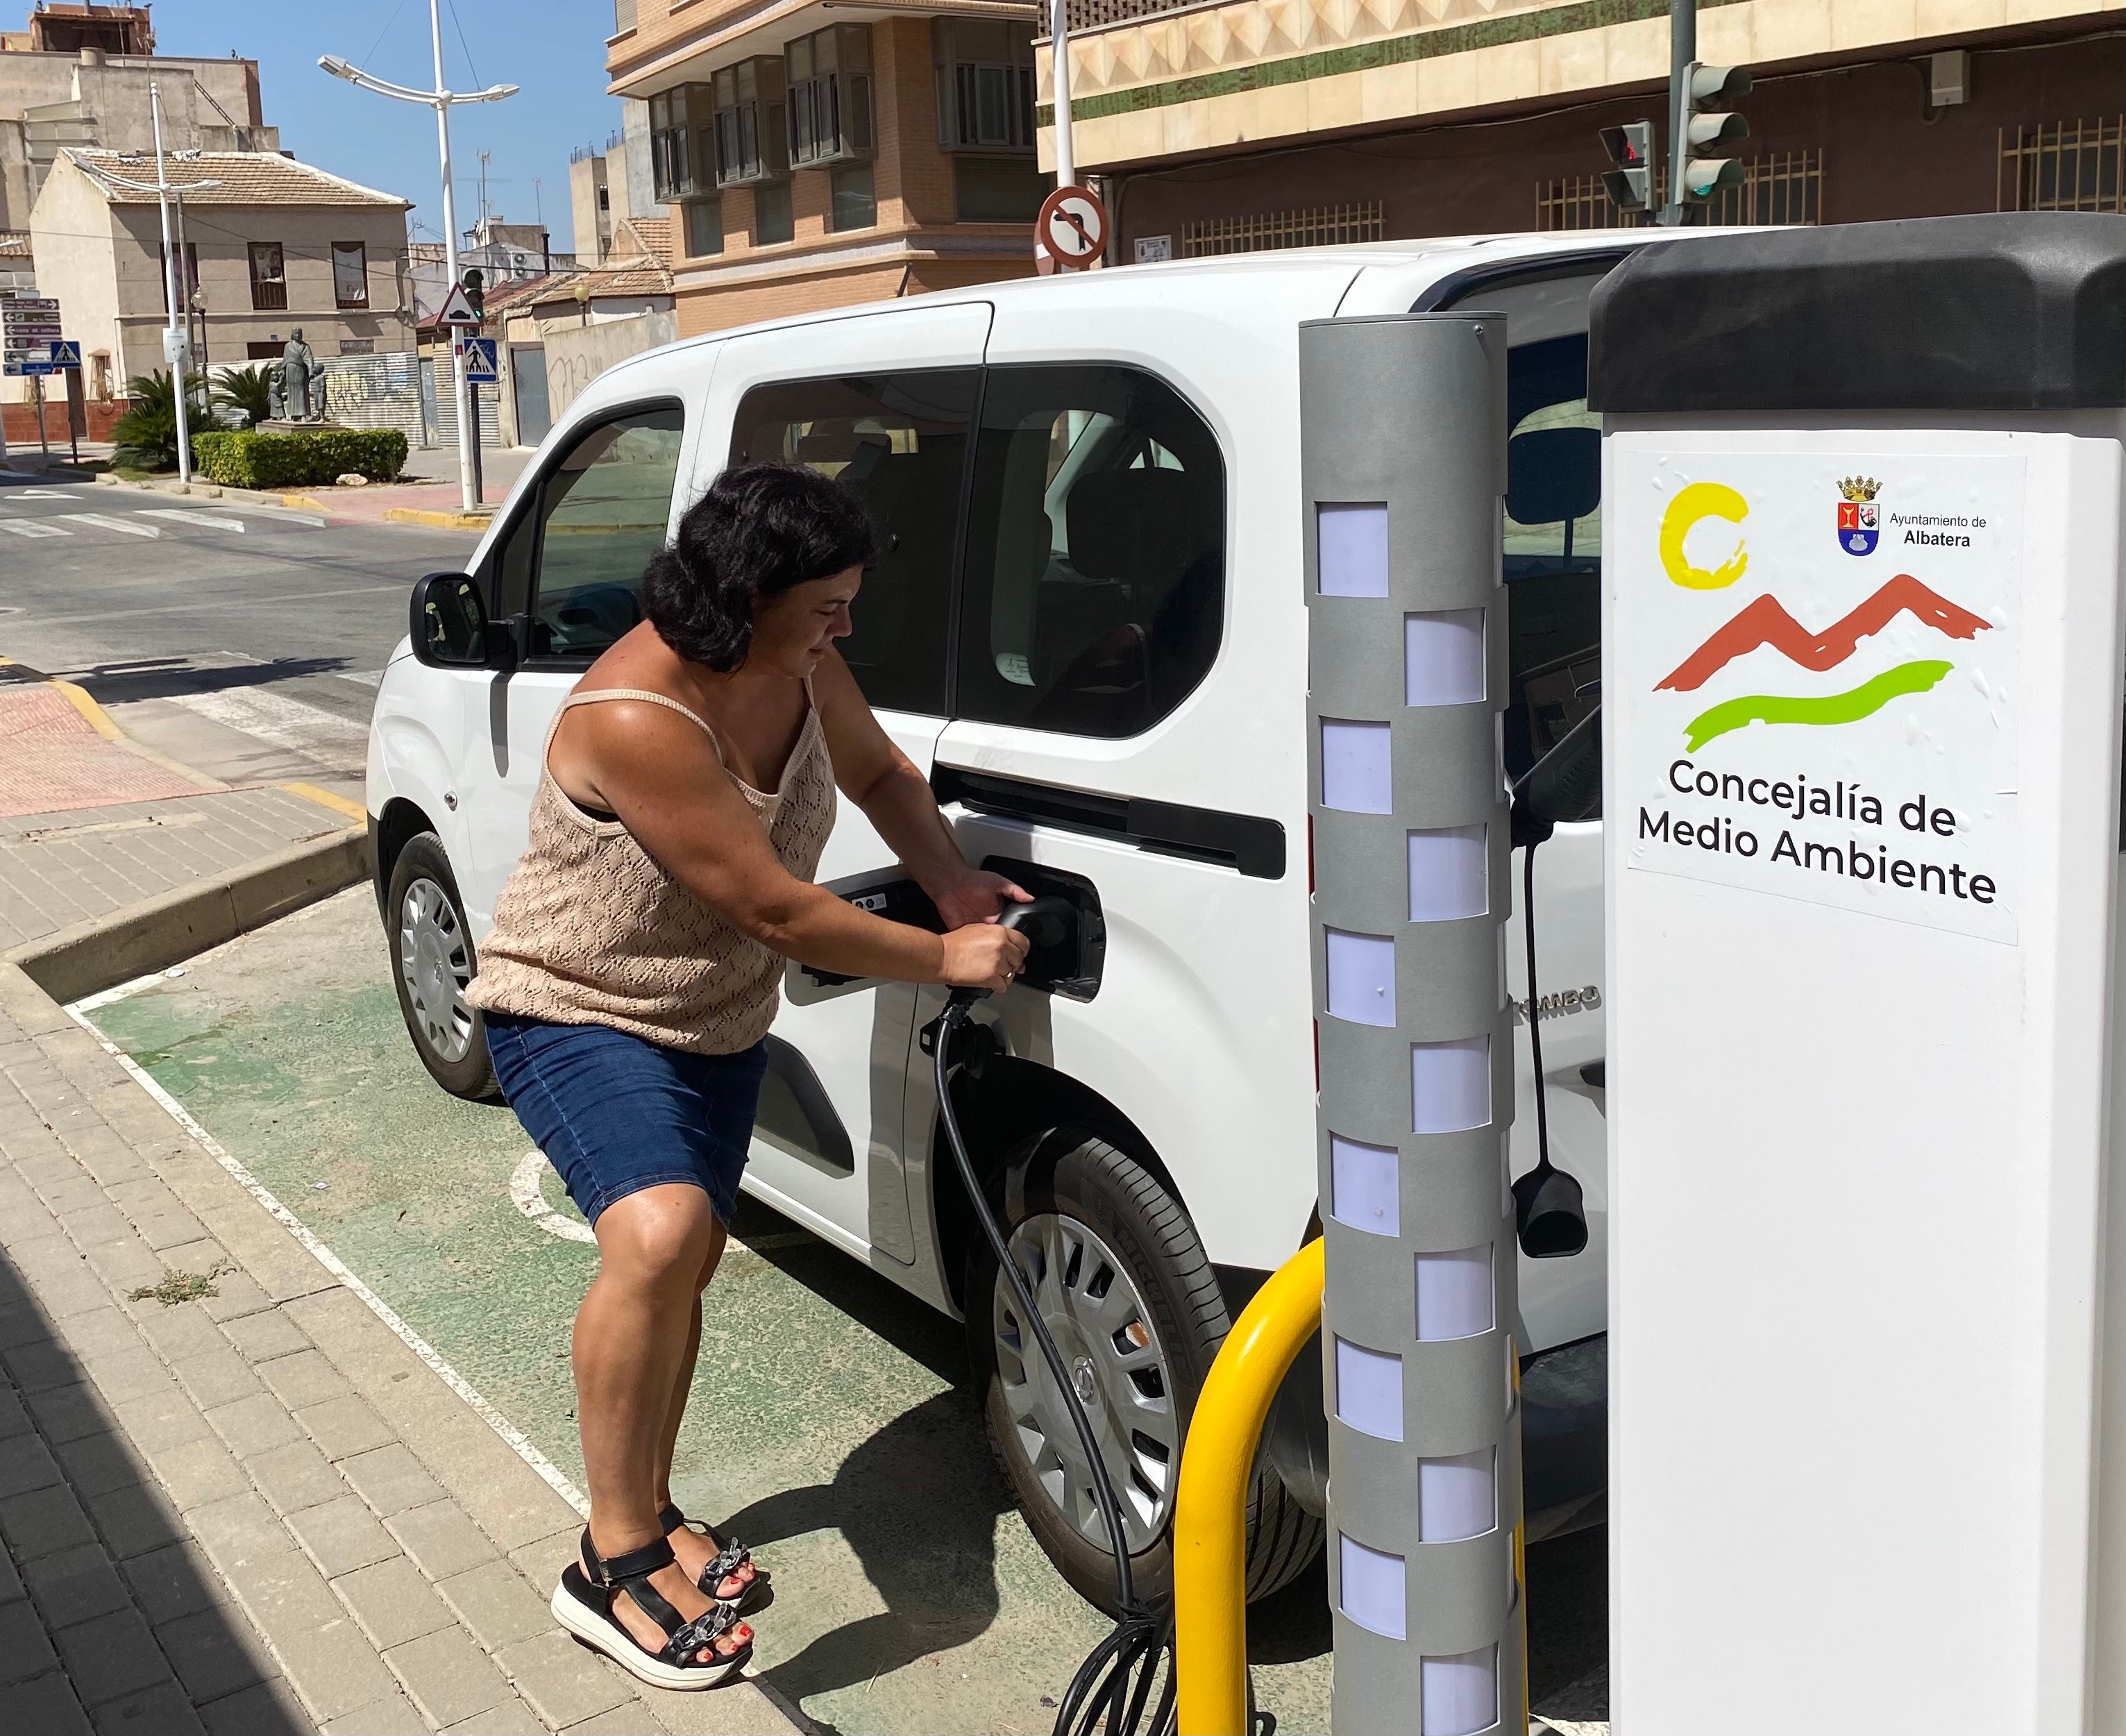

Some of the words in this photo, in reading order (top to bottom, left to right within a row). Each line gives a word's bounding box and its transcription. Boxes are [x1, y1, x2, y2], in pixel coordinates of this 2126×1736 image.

[1889, 512, 1968, 527] Ayuntamiento
[1971, 516, 1986, 528] de
[1903, 530, 1971, 548] Albatera
[1669, 759, 1882, 825] Concejalía
[1898, 793, 1957, 836] de
[1639, 807, 1759, 857] Medio
[1770, 830, 1996, 904] Ambiente
[1513, 985, 1599, 1016] OMBO
